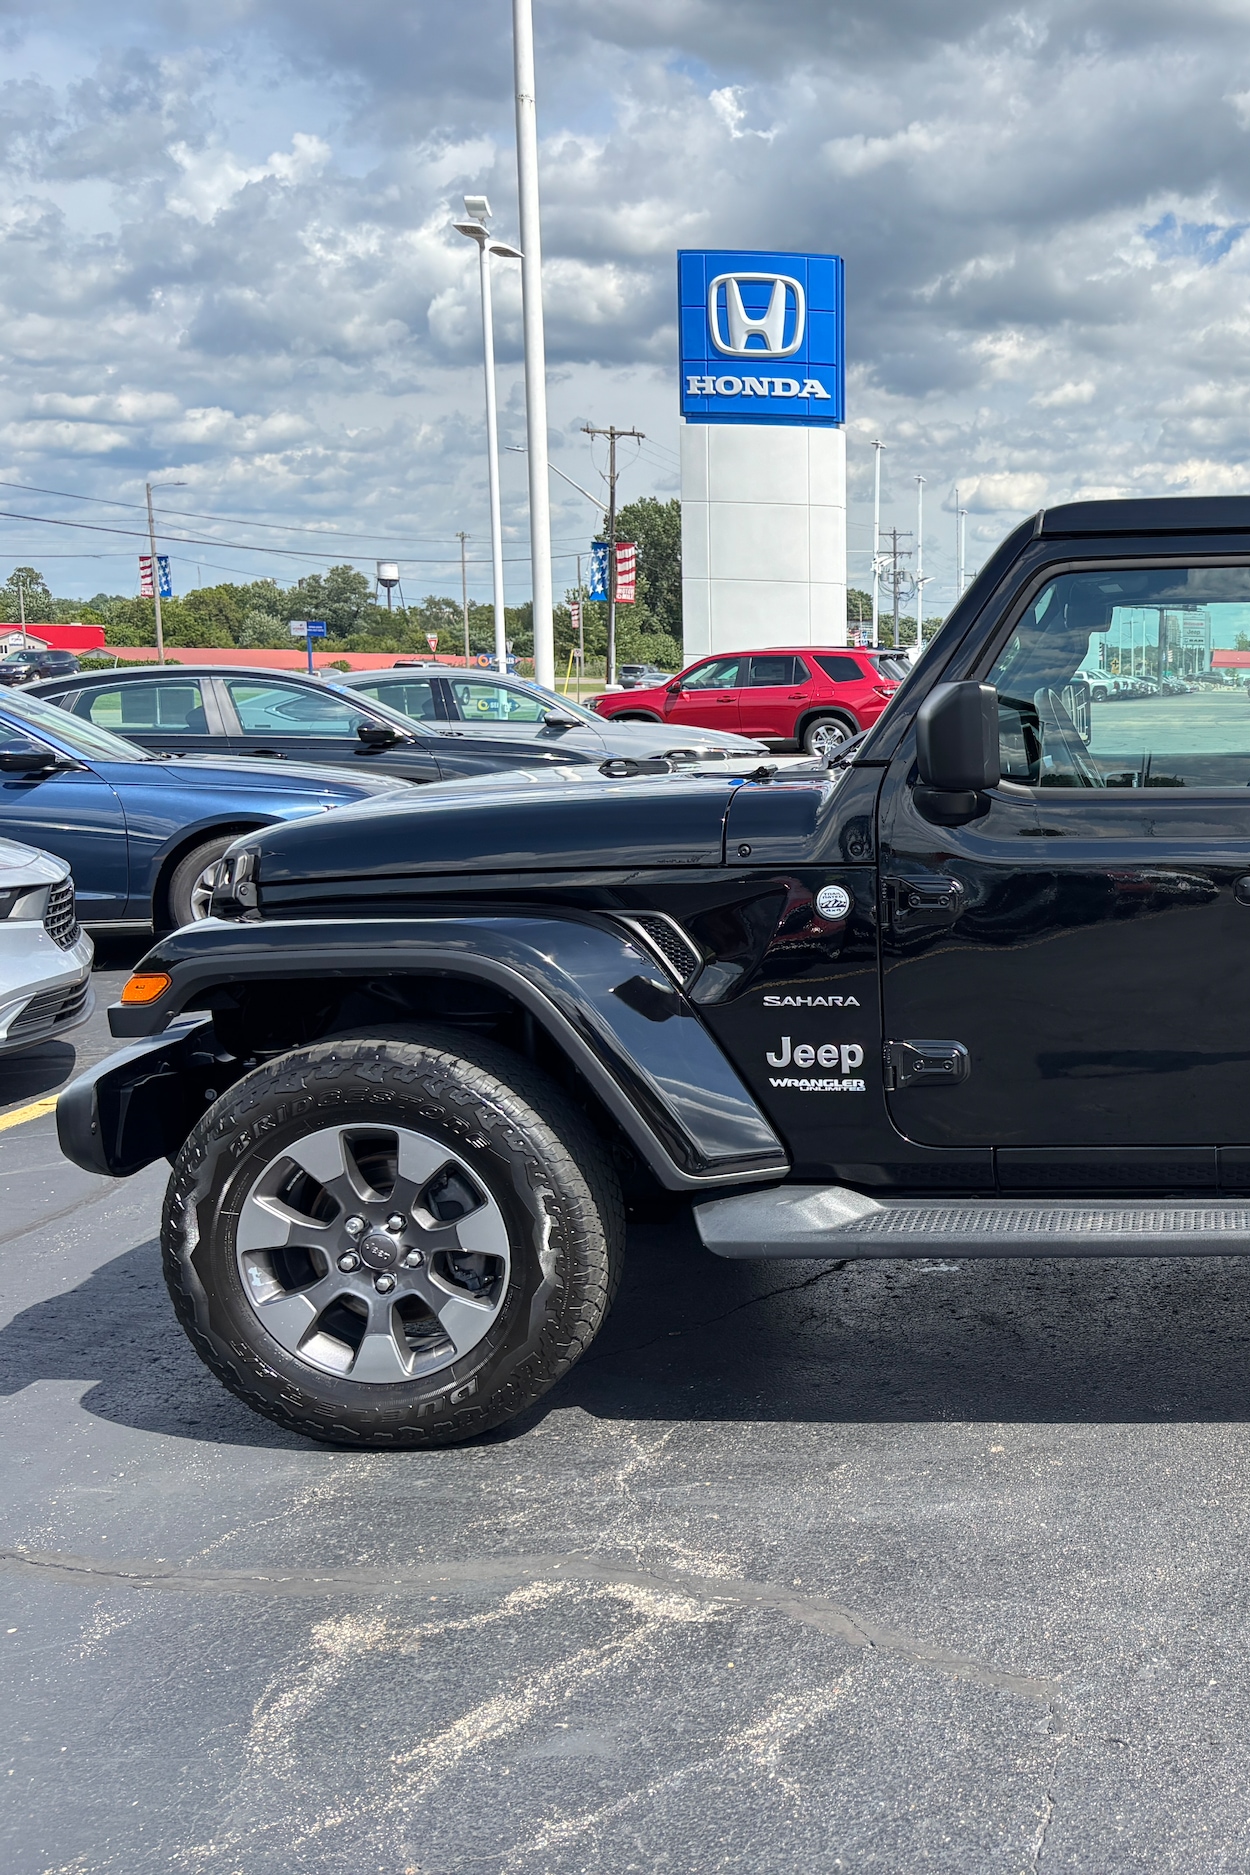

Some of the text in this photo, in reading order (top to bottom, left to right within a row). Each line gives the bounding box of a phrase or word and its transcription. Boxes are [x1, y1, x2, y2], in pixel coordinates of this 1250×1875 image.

[686, 375, 832, 399] HONDA
[763, 996, 860, 1007] SAHARA
[766, 1036, 864, 1074] Jeep
[769, 1078, 865, 1087] WRANGLER
[229, 1085, 493, 1159] BRIDGESTONE
